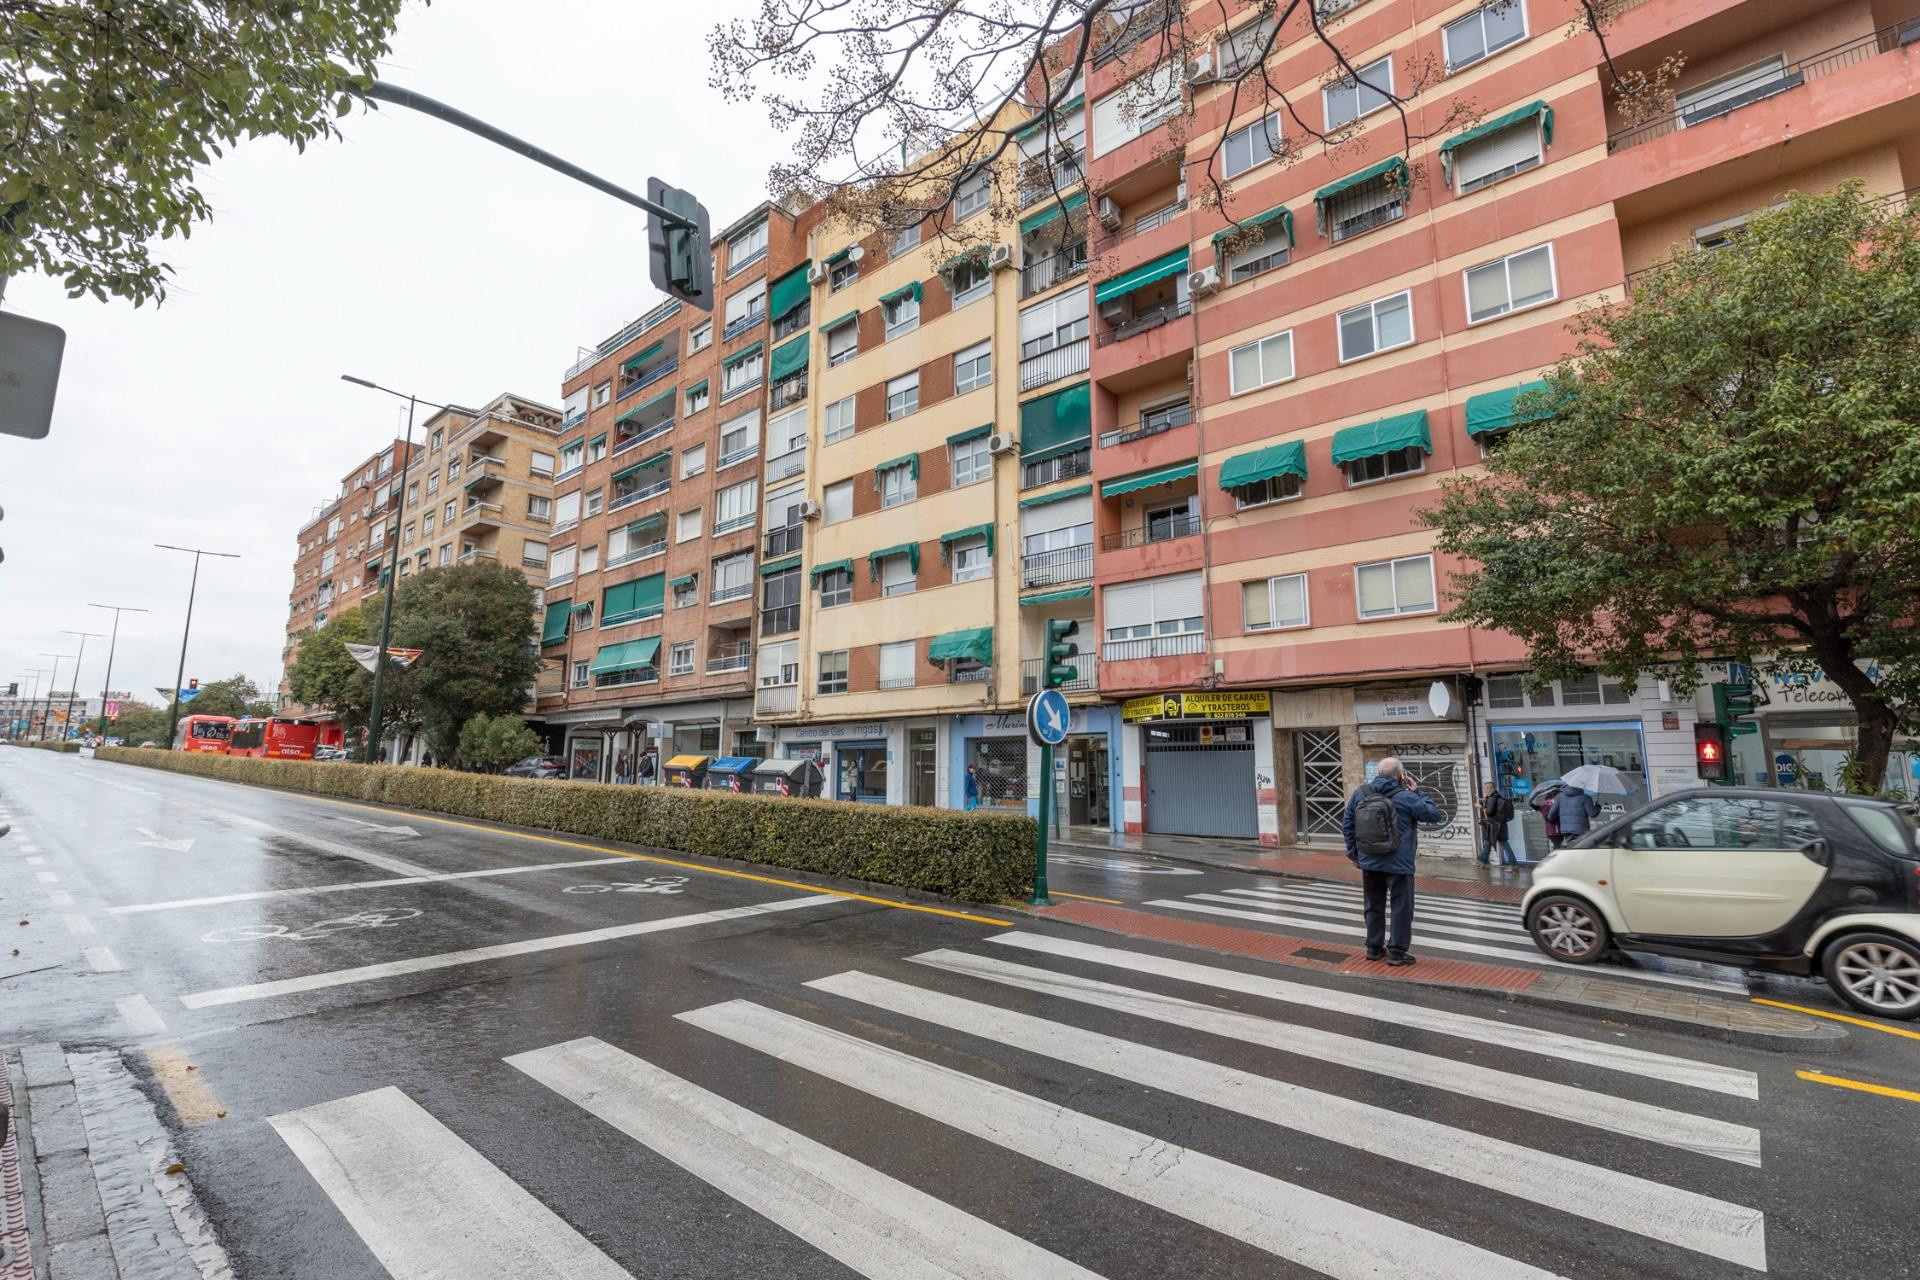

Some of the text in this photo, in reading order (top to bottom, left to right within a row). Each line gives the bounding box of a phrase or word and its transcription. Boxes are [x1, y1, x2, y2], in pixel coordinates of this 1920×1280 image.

[1184, 692, 1266, 703] ALQUILER DE GARAJES
[1202, 703, 1251, 712] Y TRASTEROS
[795, 726, 845, 738] Centro del Gas
